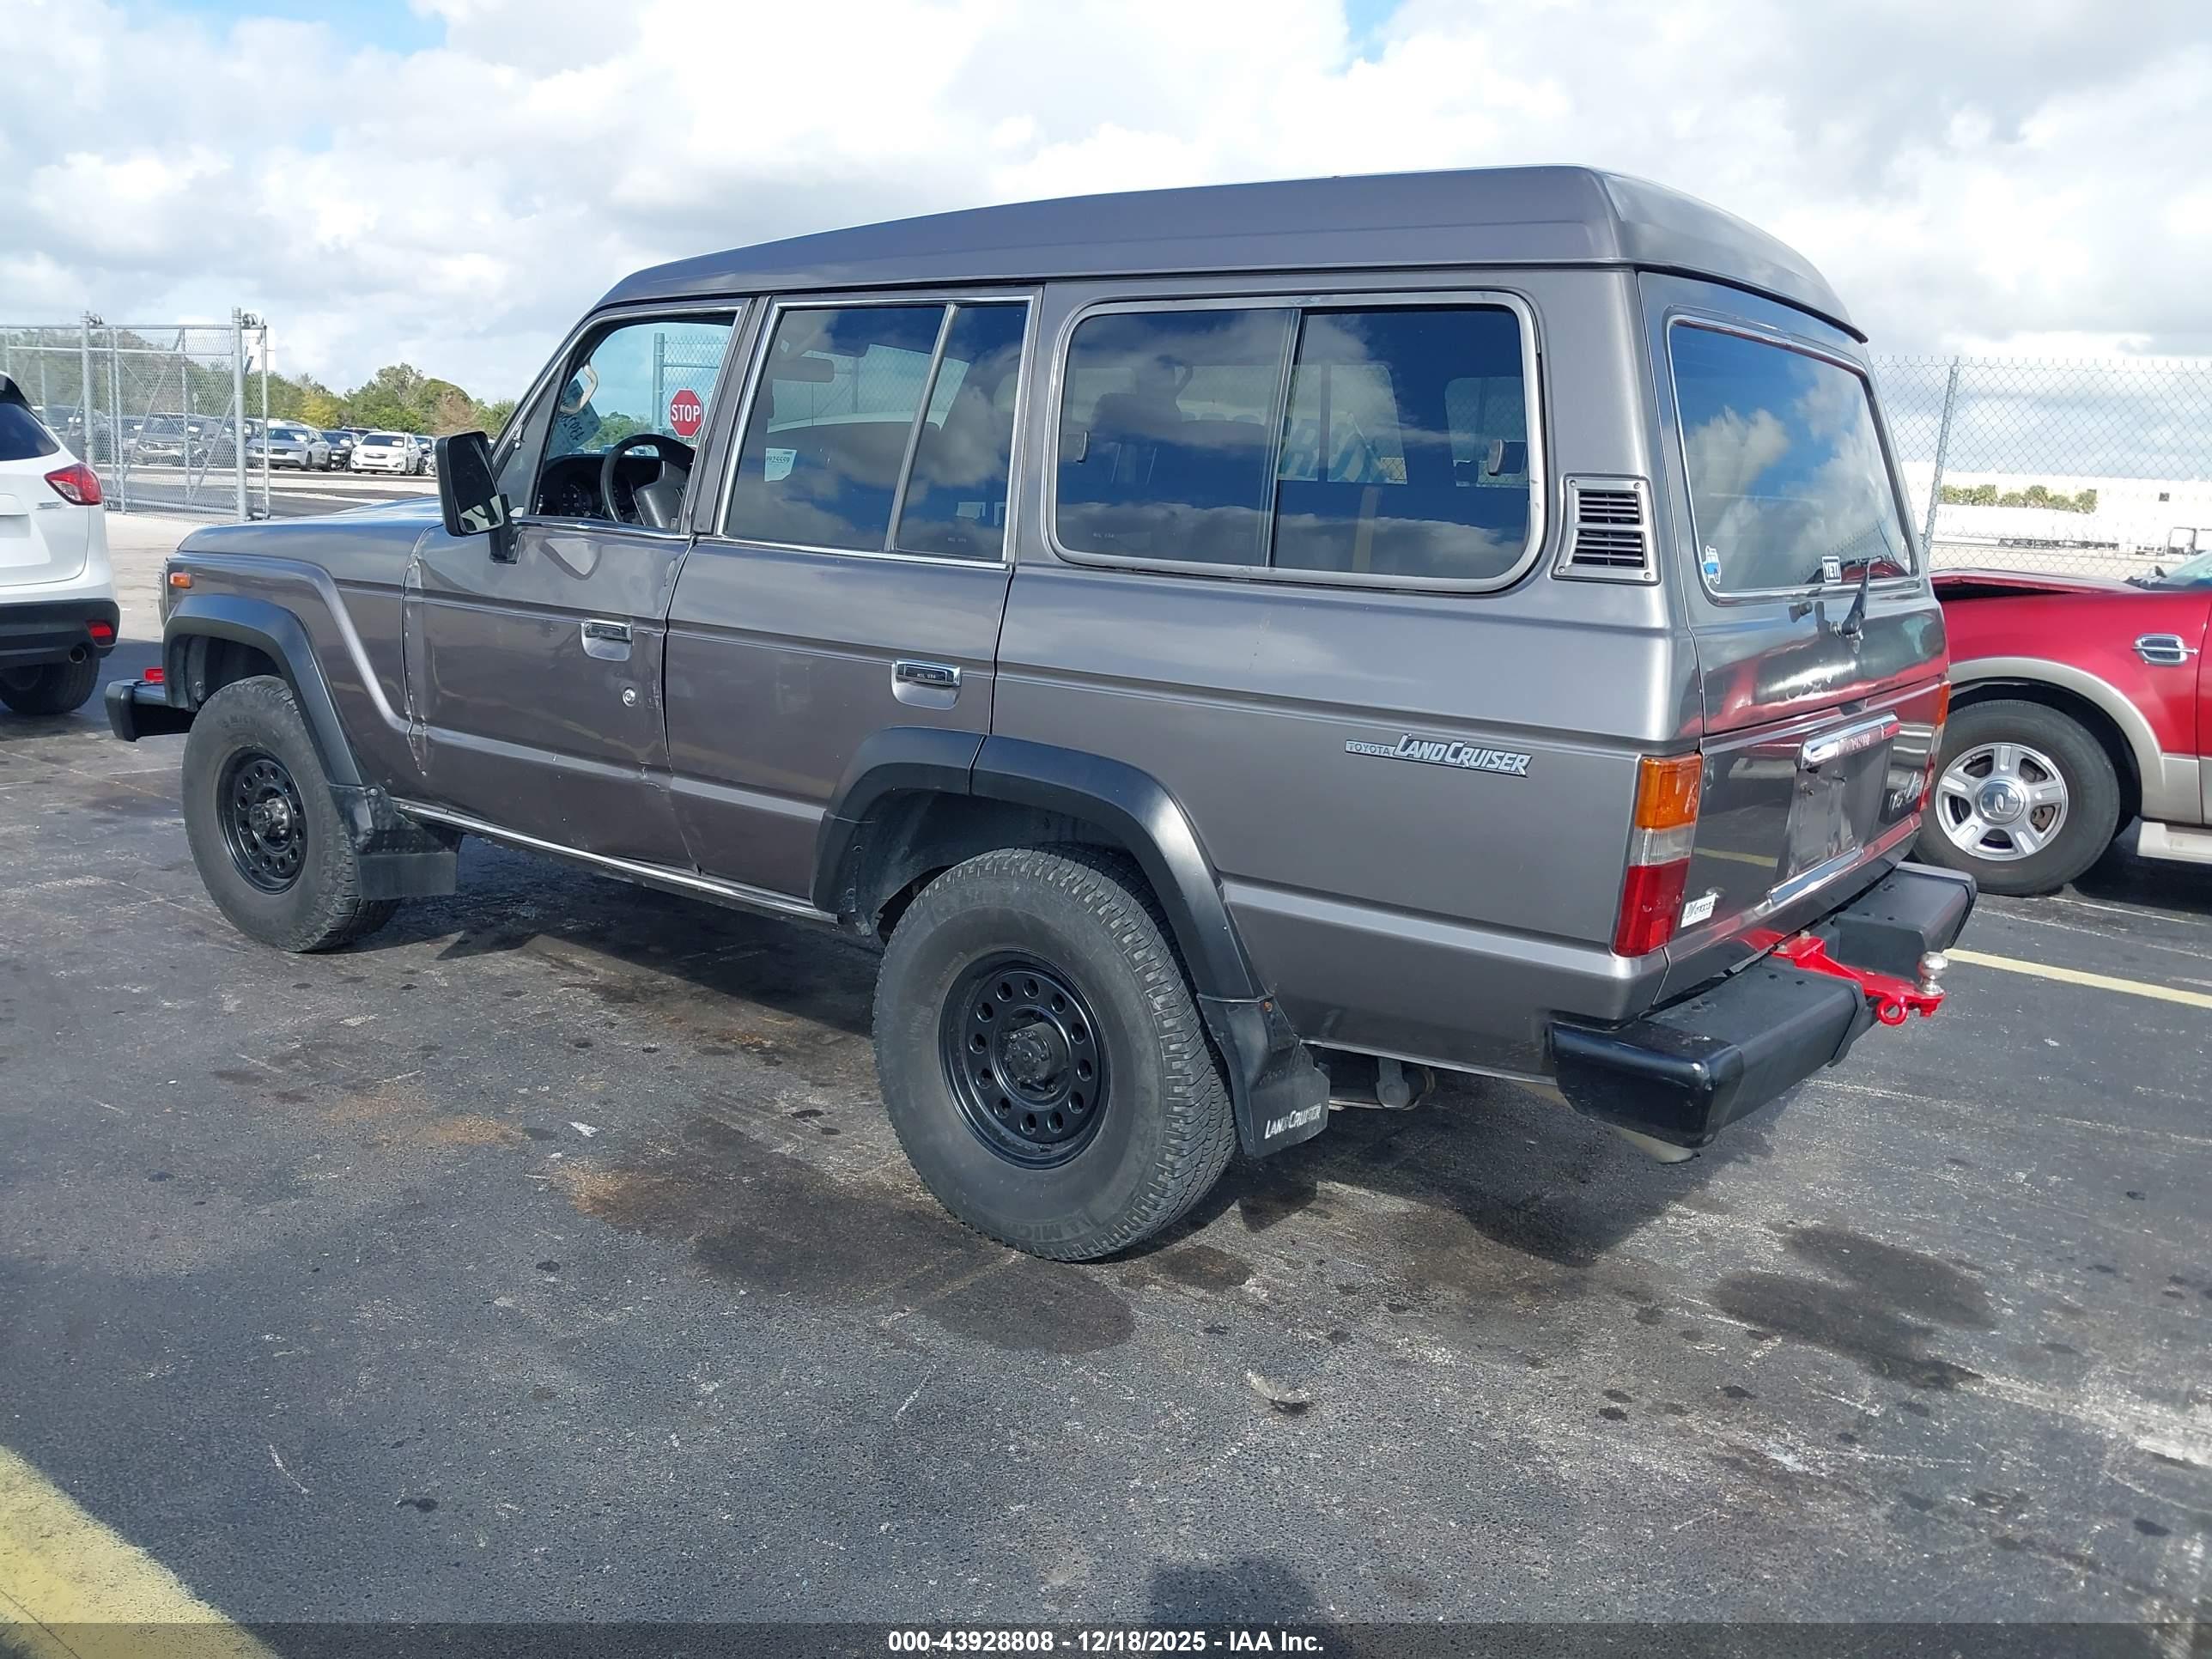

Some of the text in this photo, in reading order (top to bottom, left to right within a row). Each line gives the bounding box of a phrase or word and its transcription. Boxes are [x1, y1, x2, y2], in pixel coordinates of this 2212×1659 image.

[672, 404, 701, 422] STOP
[1823, 562, 1840, 578] YETI
[1349, 742, 1391, 756] TOYOTA
